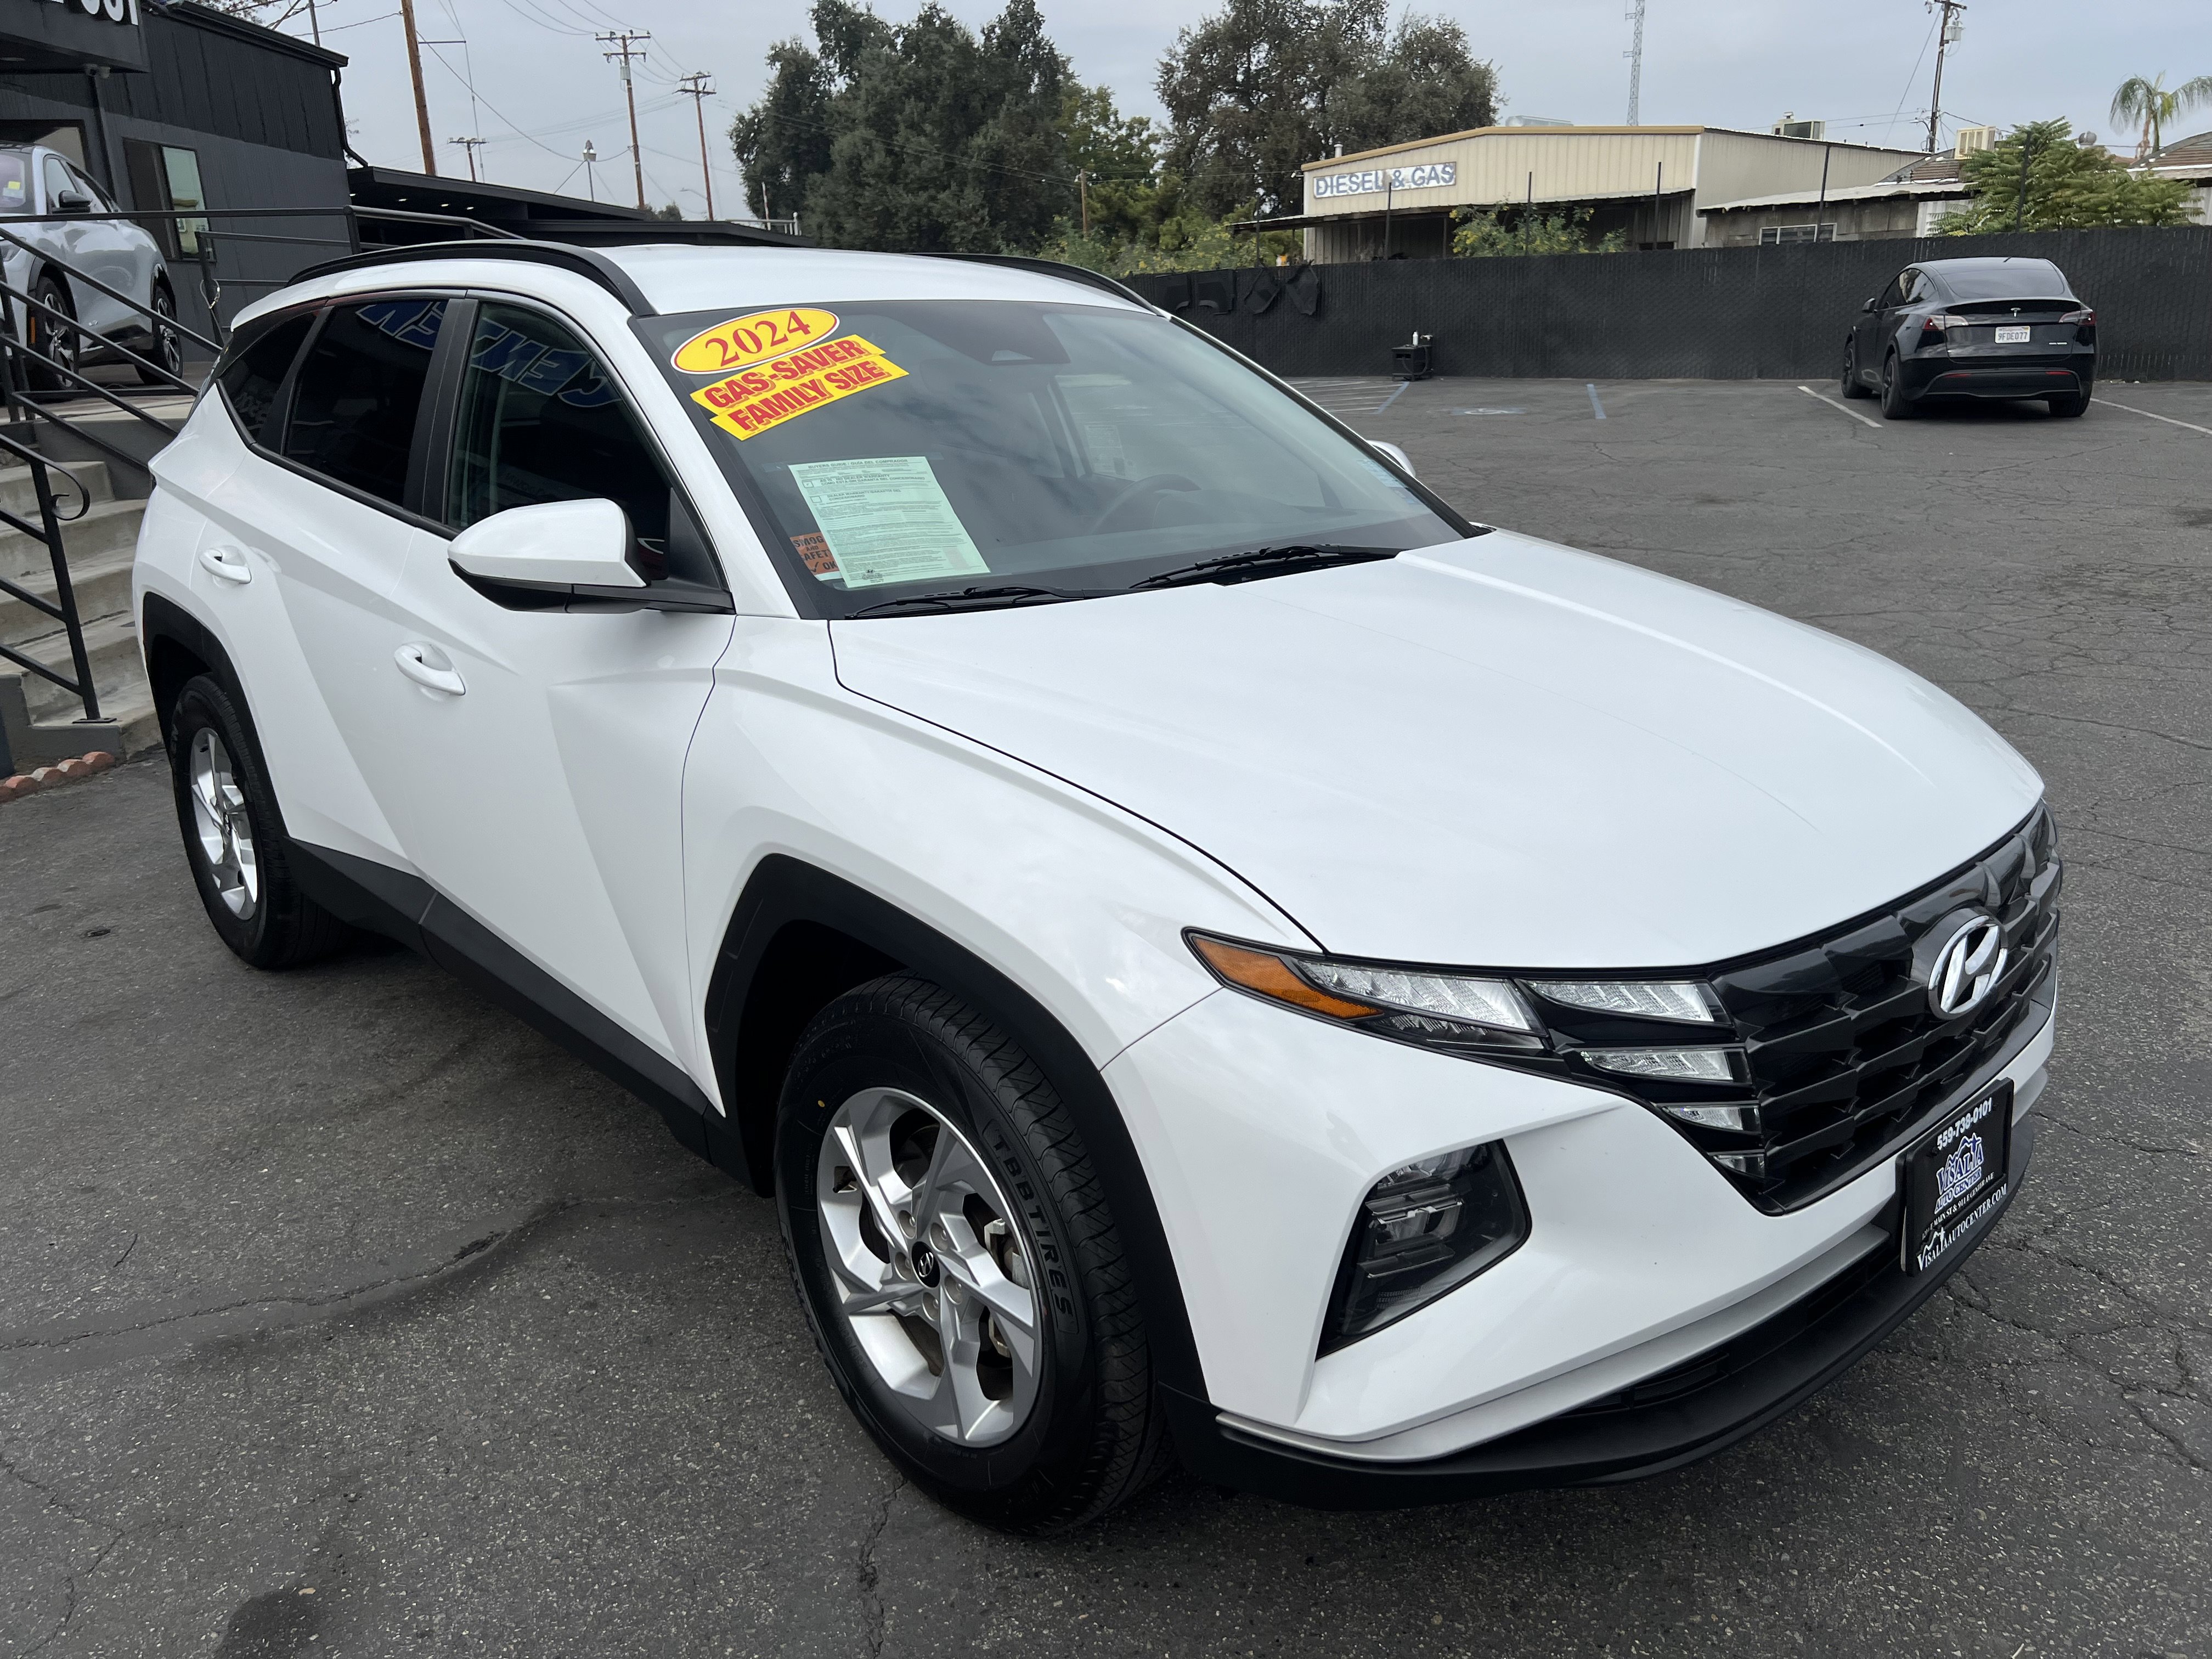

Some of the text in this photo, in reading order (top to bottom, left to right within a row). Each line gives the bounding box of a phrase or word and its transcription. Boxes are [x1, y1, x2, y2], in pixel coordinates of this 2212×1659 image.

[1316, 163, 1454, 196] DIESEL & GAS
[706, 311, 811, 367] 2024
[1998, 331, 2028, 341] 9FDE077
[704, 340, 869, 408] GAS-SAVER
[727, 360, 889, 432] FAMILY SIZE
[793, 535, 825, 548] SMOG
[802, 549, 831, 561] AFET
[822, 561, 838, 570] OK
[1937, 1097, 1993, 1150] 559-738-0101
[1934, 1166, 1982, 1214] AUTO CENTER
[1936, 1142, 1984, 1195] VISALIA
